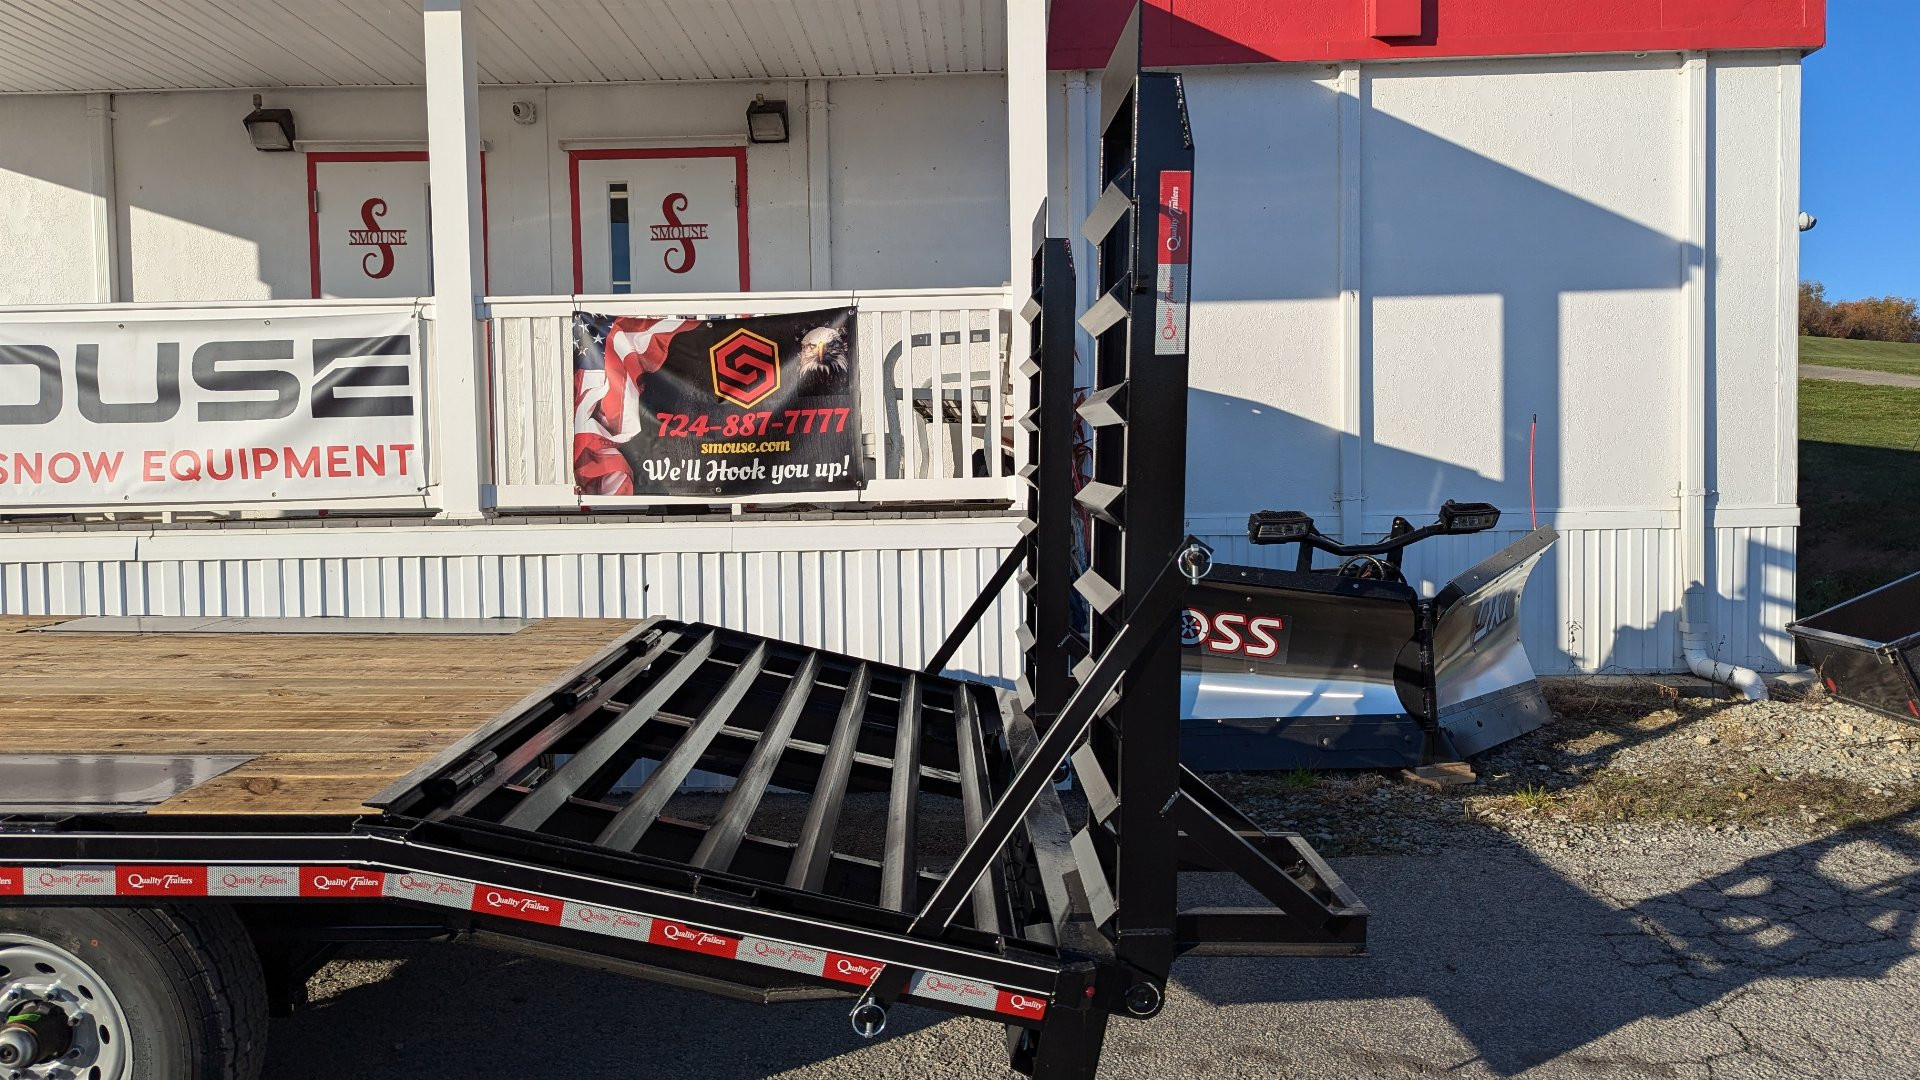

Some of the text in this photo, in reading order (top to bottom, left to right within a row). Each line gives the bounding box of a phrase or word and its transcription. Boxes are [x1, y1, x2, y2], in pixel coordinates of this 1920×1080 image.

[1167, 186, 1182, 250] Quality Trailers
[349, 230, 407, 245] SMOUSE
[650, 224, 708, 240] SMOUSE
[656, 408, 850, 438] 724-887-7777
[701, 440, 791, 454] smouse.com
[143, 444, 414, 482] EQUIPMENT
[643, 455, 850, 485] We'll Hook you up!
[128, 873, 193, 889] Quality Trailers
[314, 875, 379, 890] Quality Trailers
[487, 892, 550, 912] Quality Trailers
[664, 925, 726, 945] Quality Trailers
[837, 959, 870, 975] Quality
[1010, 994, 1044, 1010] Quality
